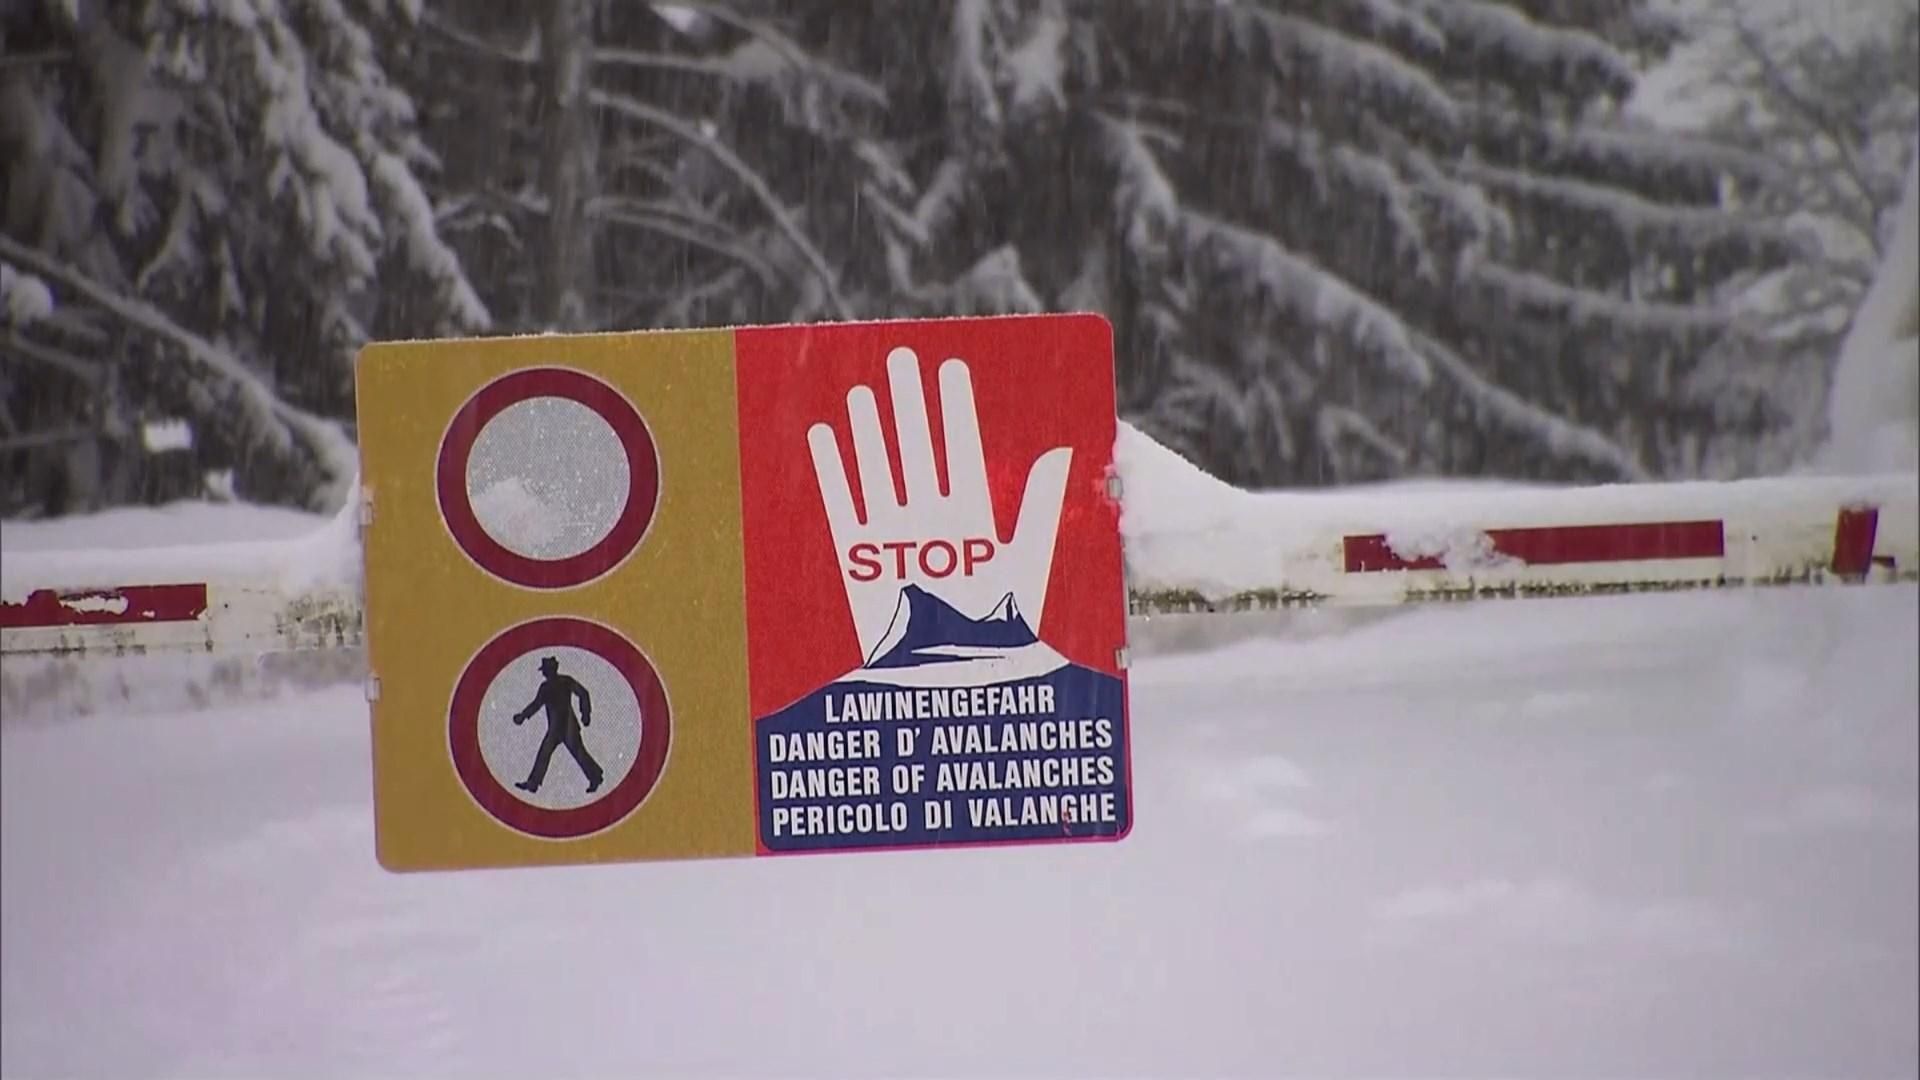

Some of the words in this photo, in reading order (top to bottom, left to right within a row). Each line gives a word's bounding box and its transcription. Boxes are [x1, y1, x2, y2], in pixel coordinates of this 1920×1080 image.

[848, 538, 995, 582] STOP
[825, 685, 1055, 723] LAWINENGEFAHR
[769, 729, 881, 763] DANGER
[931, 719, 1112, 755] AVALANCHES
[771, 766, 880, 800] DANGER
[892, 764, 925, 794] OF
[937, 756, 1114, 792] AVALANCHES
[773, 803, 907, 837] PERICOLO
[925, 800, 952, 830] DI
[968, 794, 1116, 827] VALANGHE
